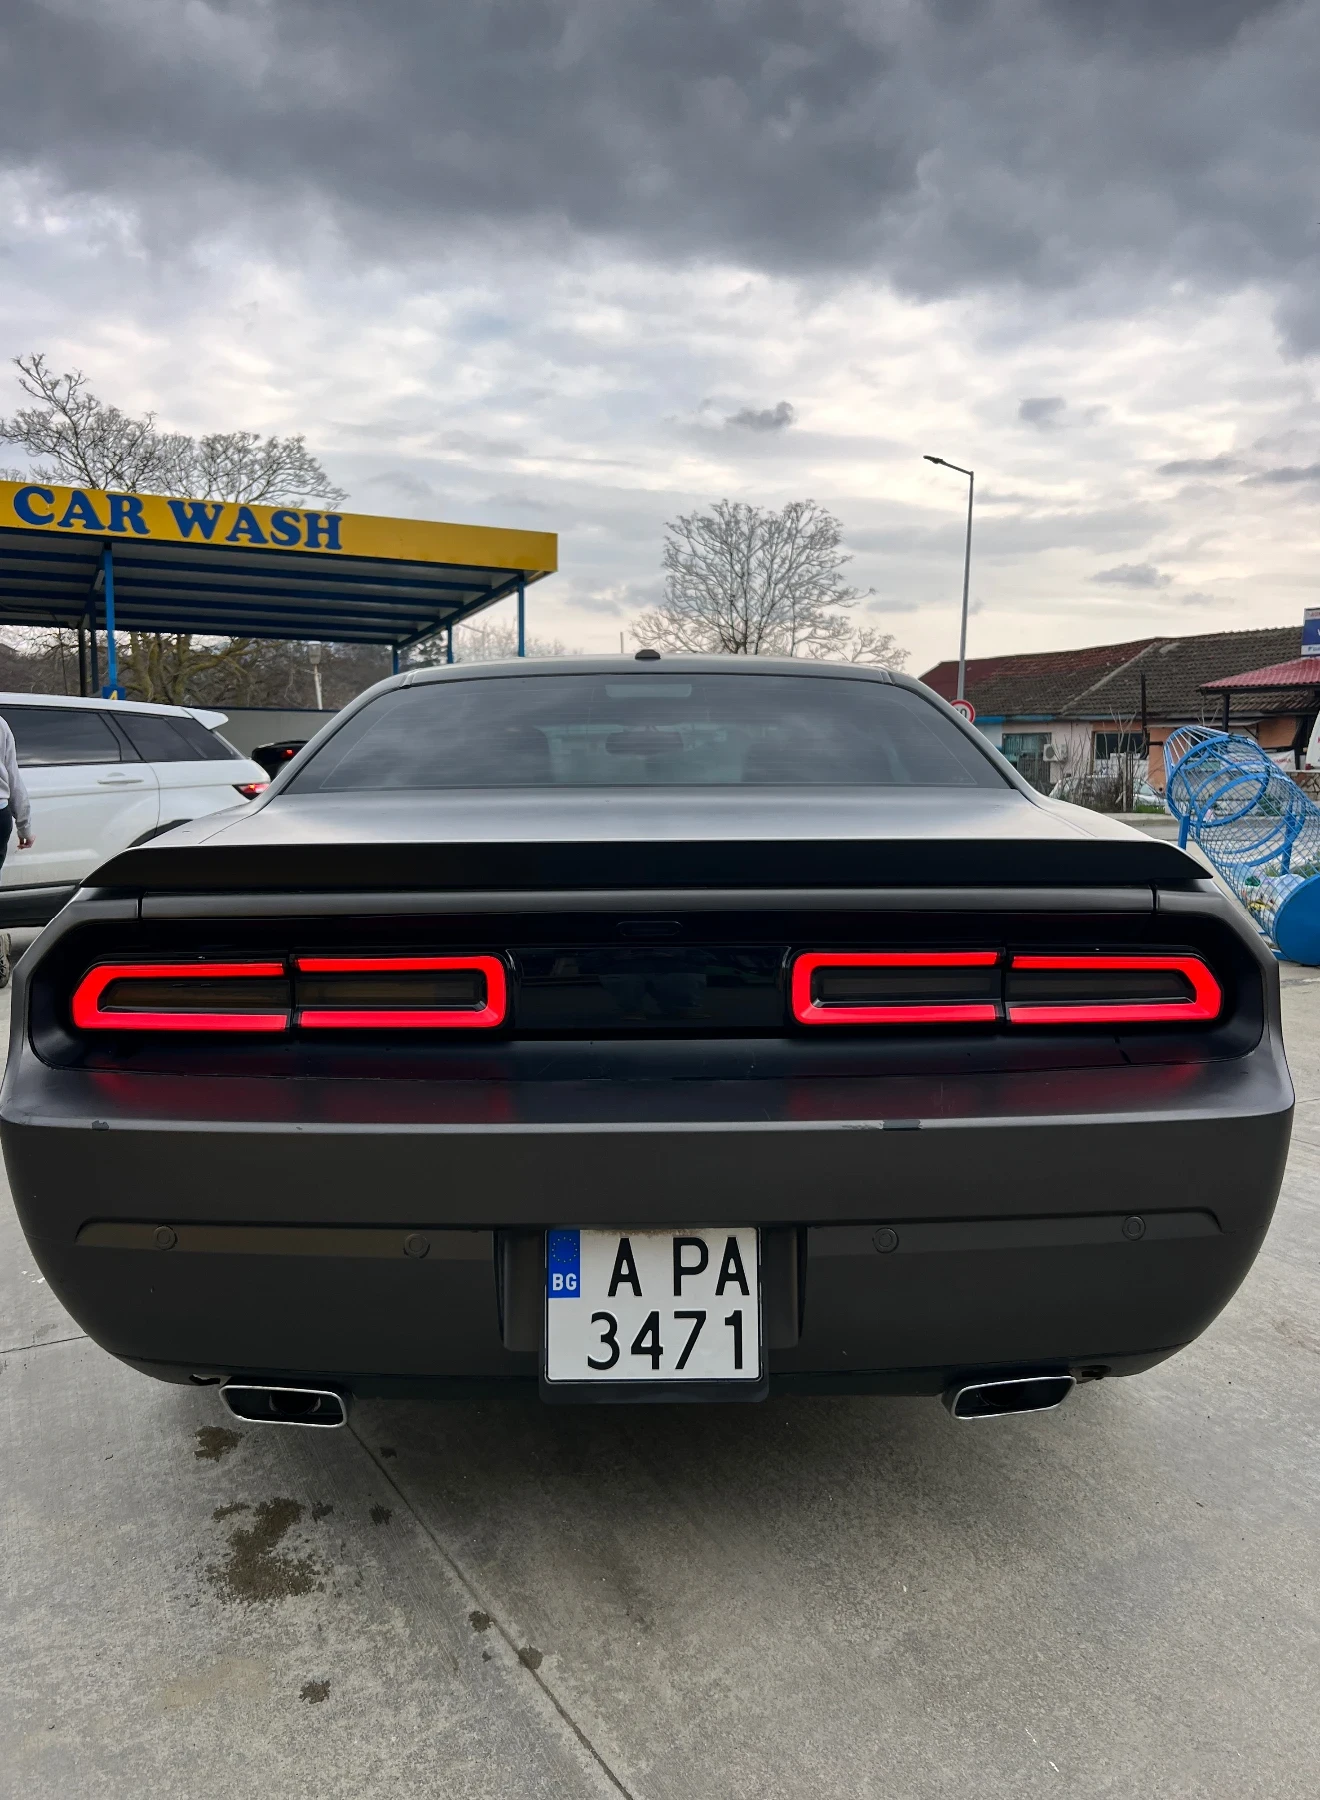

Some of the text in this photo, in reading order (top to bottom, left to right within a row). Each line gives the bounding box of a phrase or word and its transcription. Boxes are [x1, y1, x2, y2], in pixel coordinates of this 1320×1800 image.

[13, 486, 343, 550] CAR WASH
[552, 1273, 577, 1291] BG
[608, 1236, 750, 1297] A PA
[587, 1310, 743, 1371] 3471
